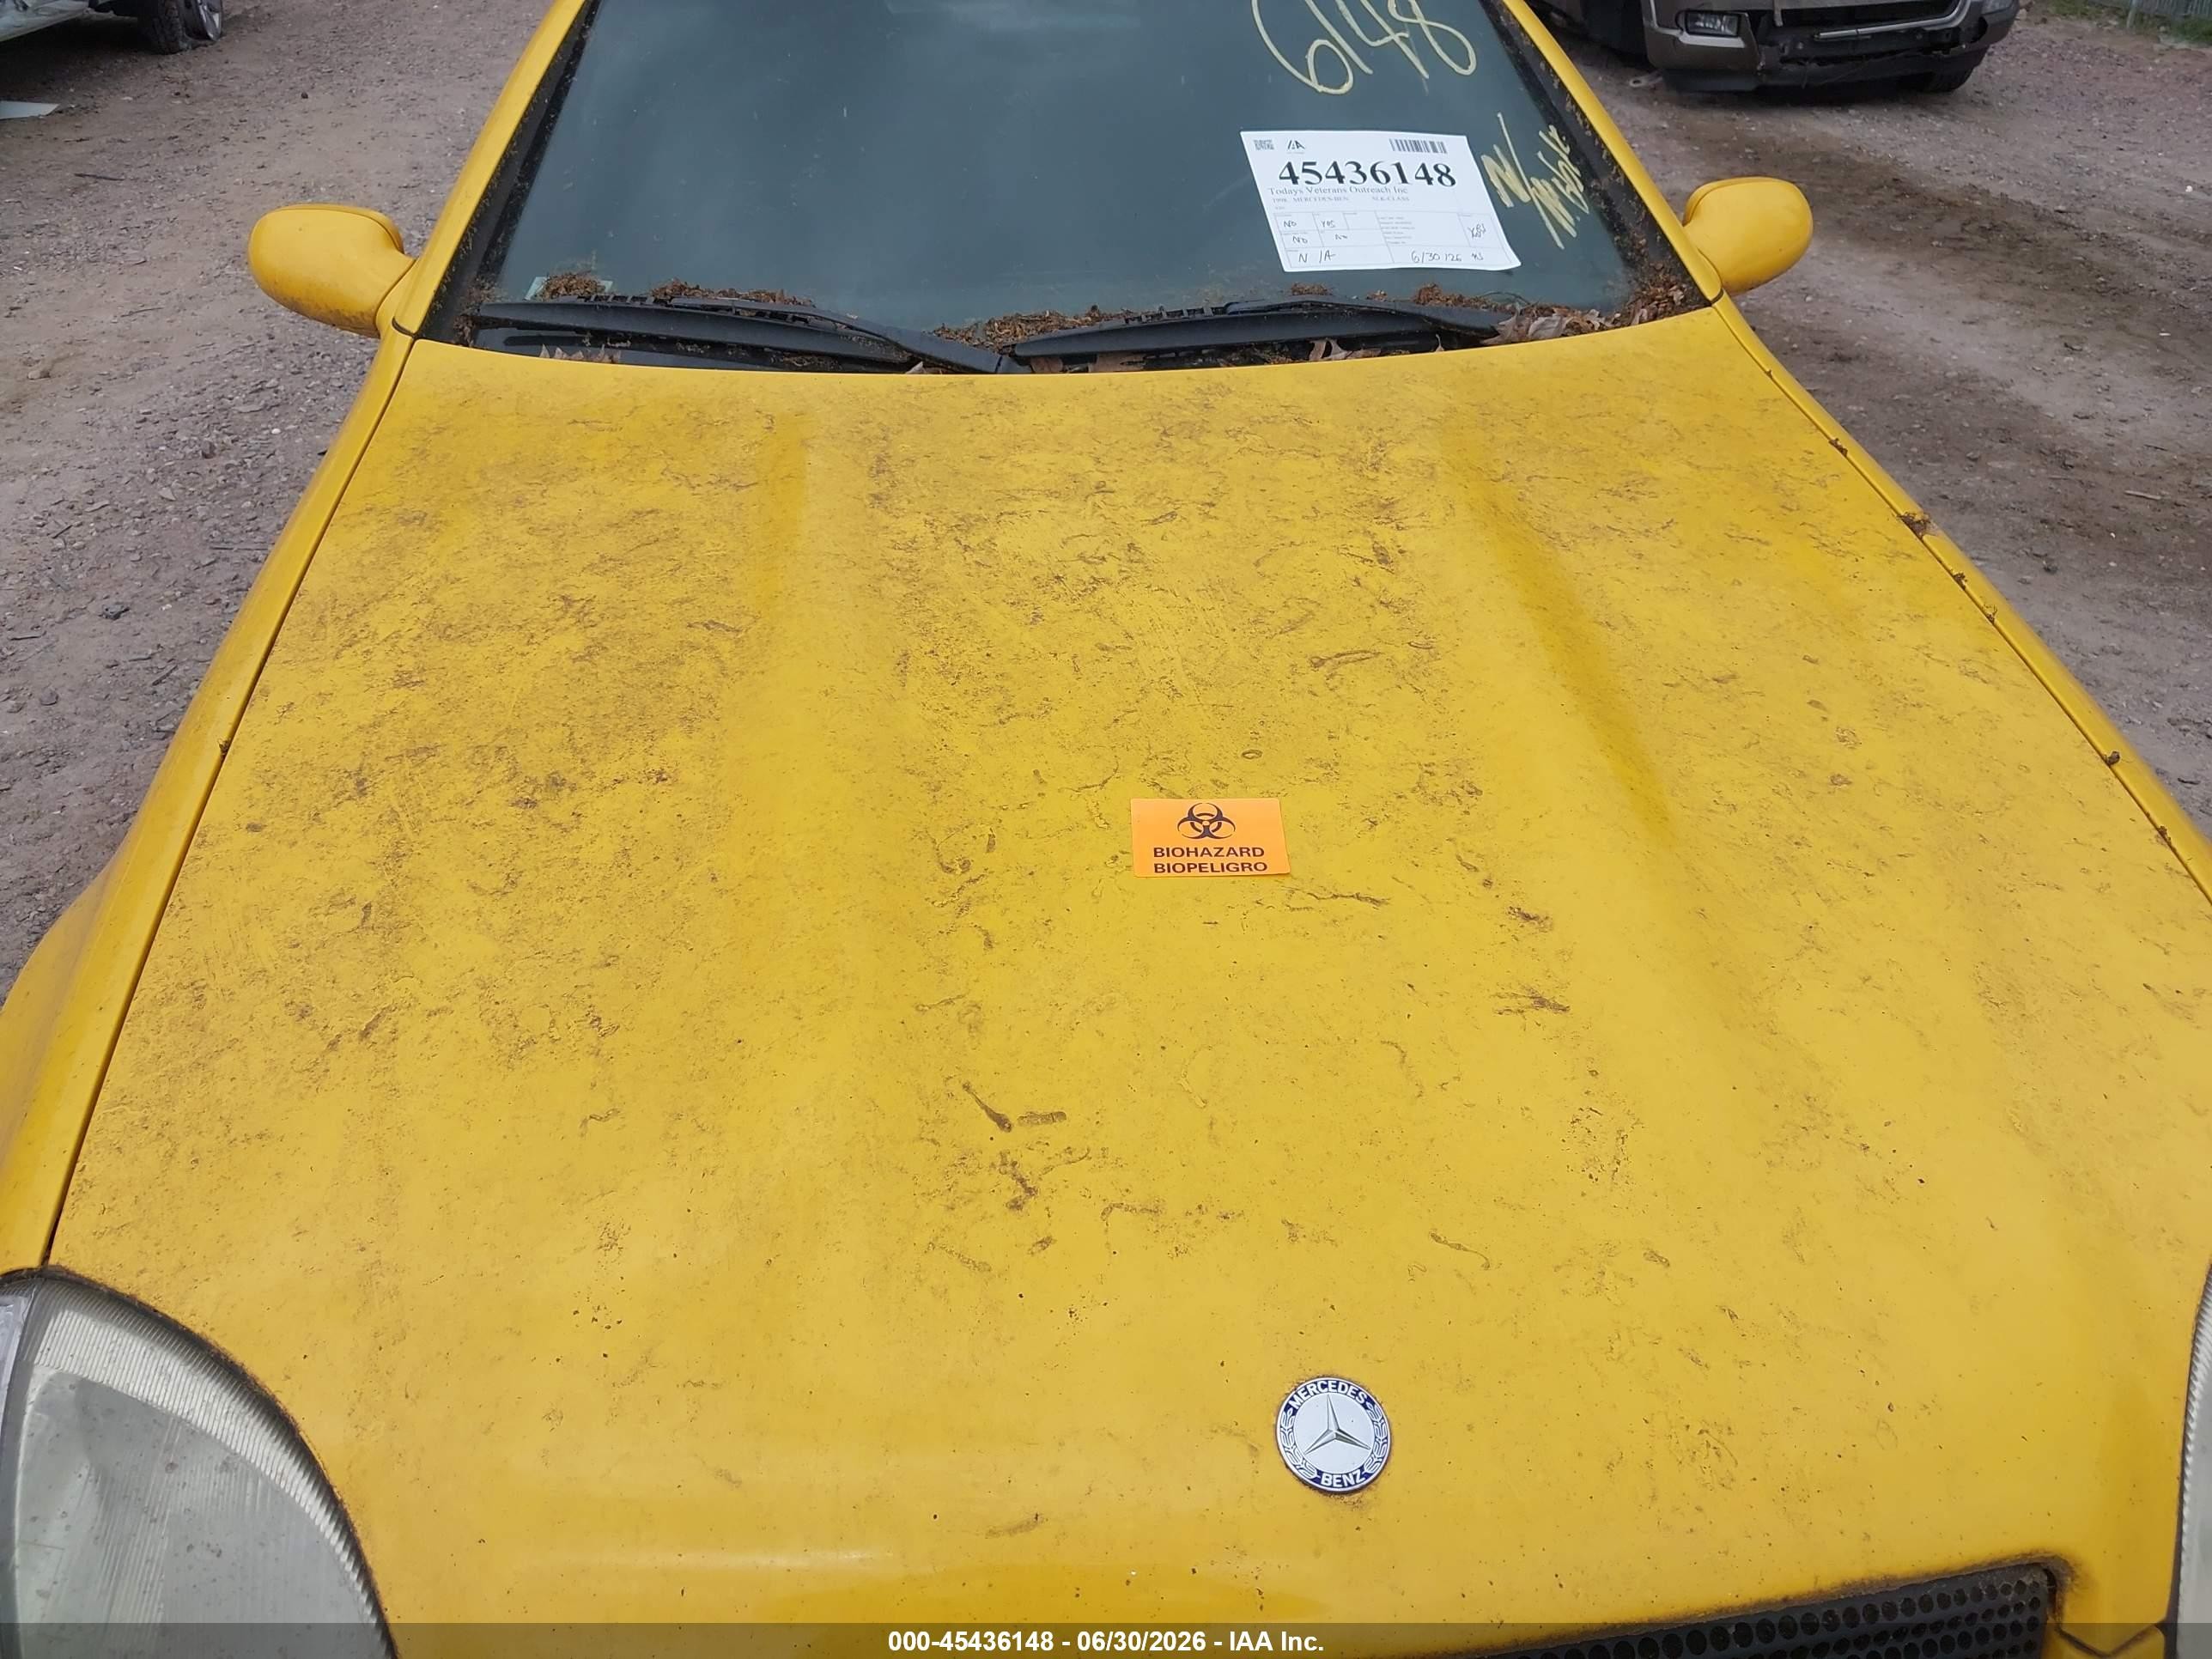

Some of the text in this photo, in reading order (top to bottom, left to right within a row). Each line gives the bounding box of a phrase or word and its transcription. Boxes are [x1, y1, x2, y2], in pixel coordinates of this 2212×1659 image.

[1279, 161, 1456, 187] 45436148
[1269, 185, 1408, 197] Todays Veterans Outreach Inc
[1153, 847, 1265, 858] BIOHAZARD
[1154, 861, 1267, 873] BIOPELIGRO
[1288, 1380, 1368, 1410] MERCEDES
[1321, 1469, 1366, 1487] BENZ
